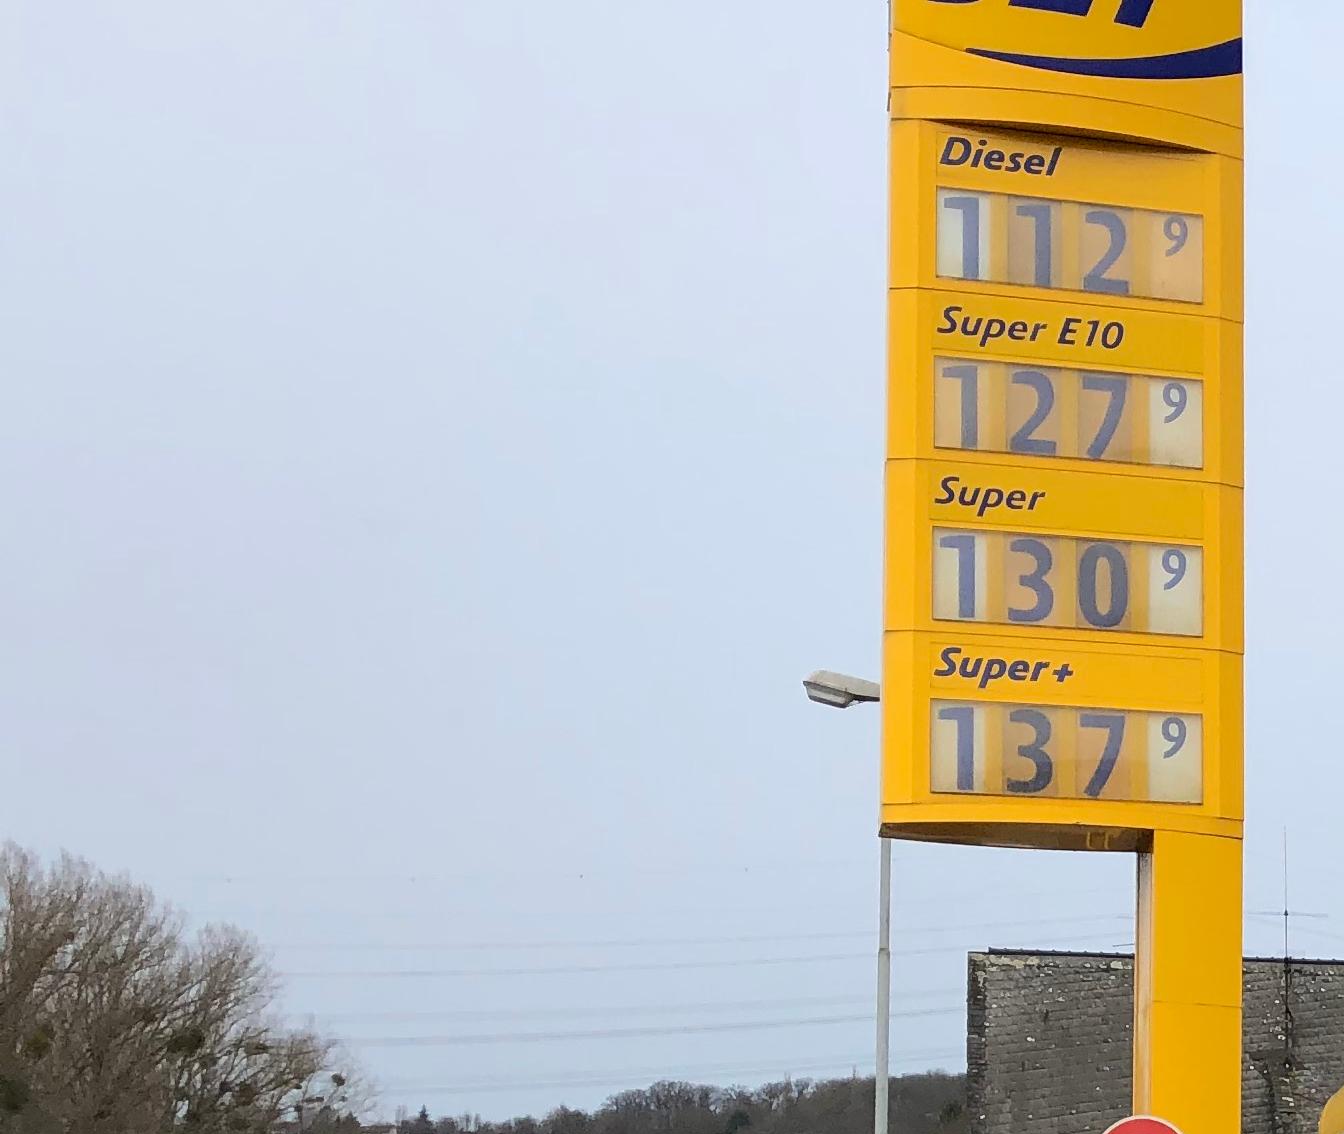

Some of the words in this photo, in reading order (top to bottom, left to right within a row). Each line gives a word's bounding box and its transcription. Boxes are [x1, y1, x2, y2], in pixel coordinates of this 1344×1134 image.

[940, 137, 1062, 176] Diesel
[937, 306, 1047, 347] Super
[1058, 318, 1124, 349] E10
[934, 476, 1046, 517] Super
[934, 647, 1074, 688] Super+
